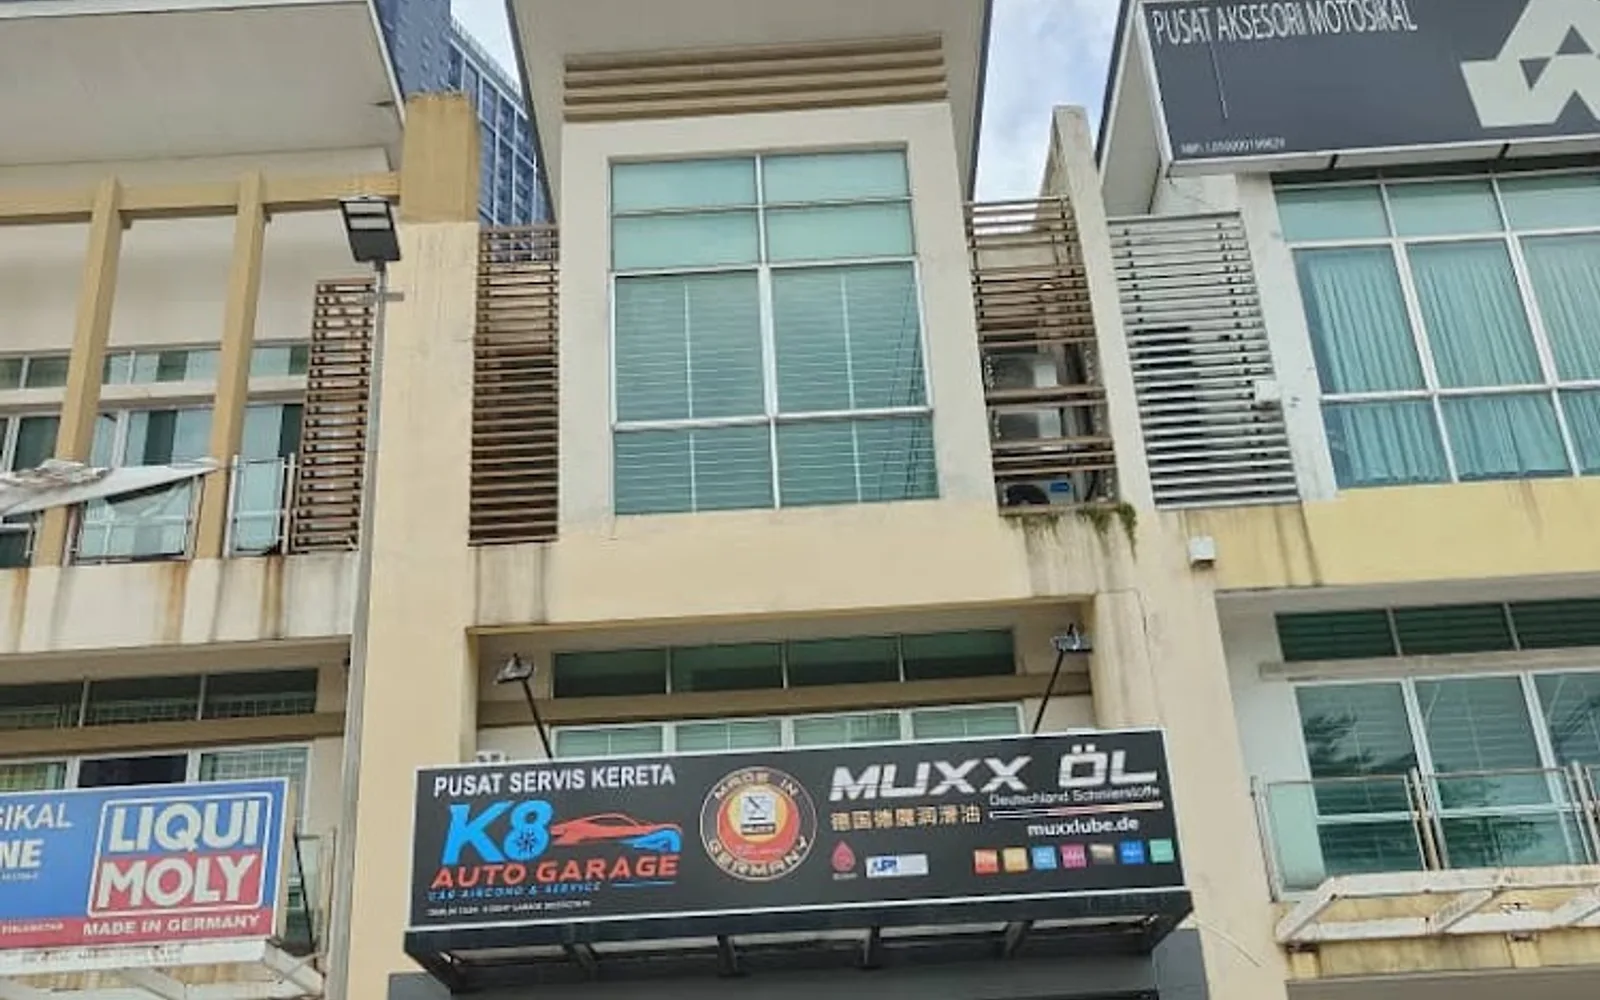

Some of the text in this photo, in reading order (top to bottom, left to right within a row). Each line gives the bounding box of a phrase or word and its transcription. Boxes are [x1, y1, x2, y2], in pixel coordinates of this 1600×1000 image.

[1152, 0, 1418, 46] PUSAT AKSESORI MOTOSIKAL
[433, 763, 676, 797] PUSAT SERVIS KERETA
[715, 770, 801, 800] MADE IN
[829, 743, 1159, 801] MUXX ÖL
[109, 800, 260, 852] LIQUI
[441, 800, 554, 866] K8
[1027, 816, 1141, 836] muxxlube.de
[431, 855, 682, 889] AUTO GARAGE
[708, 835, 808, 877] GERMANY
[96, 854, 257, 908] MOLY
[83, 914, 260, 935] MADE IN GERMANY
